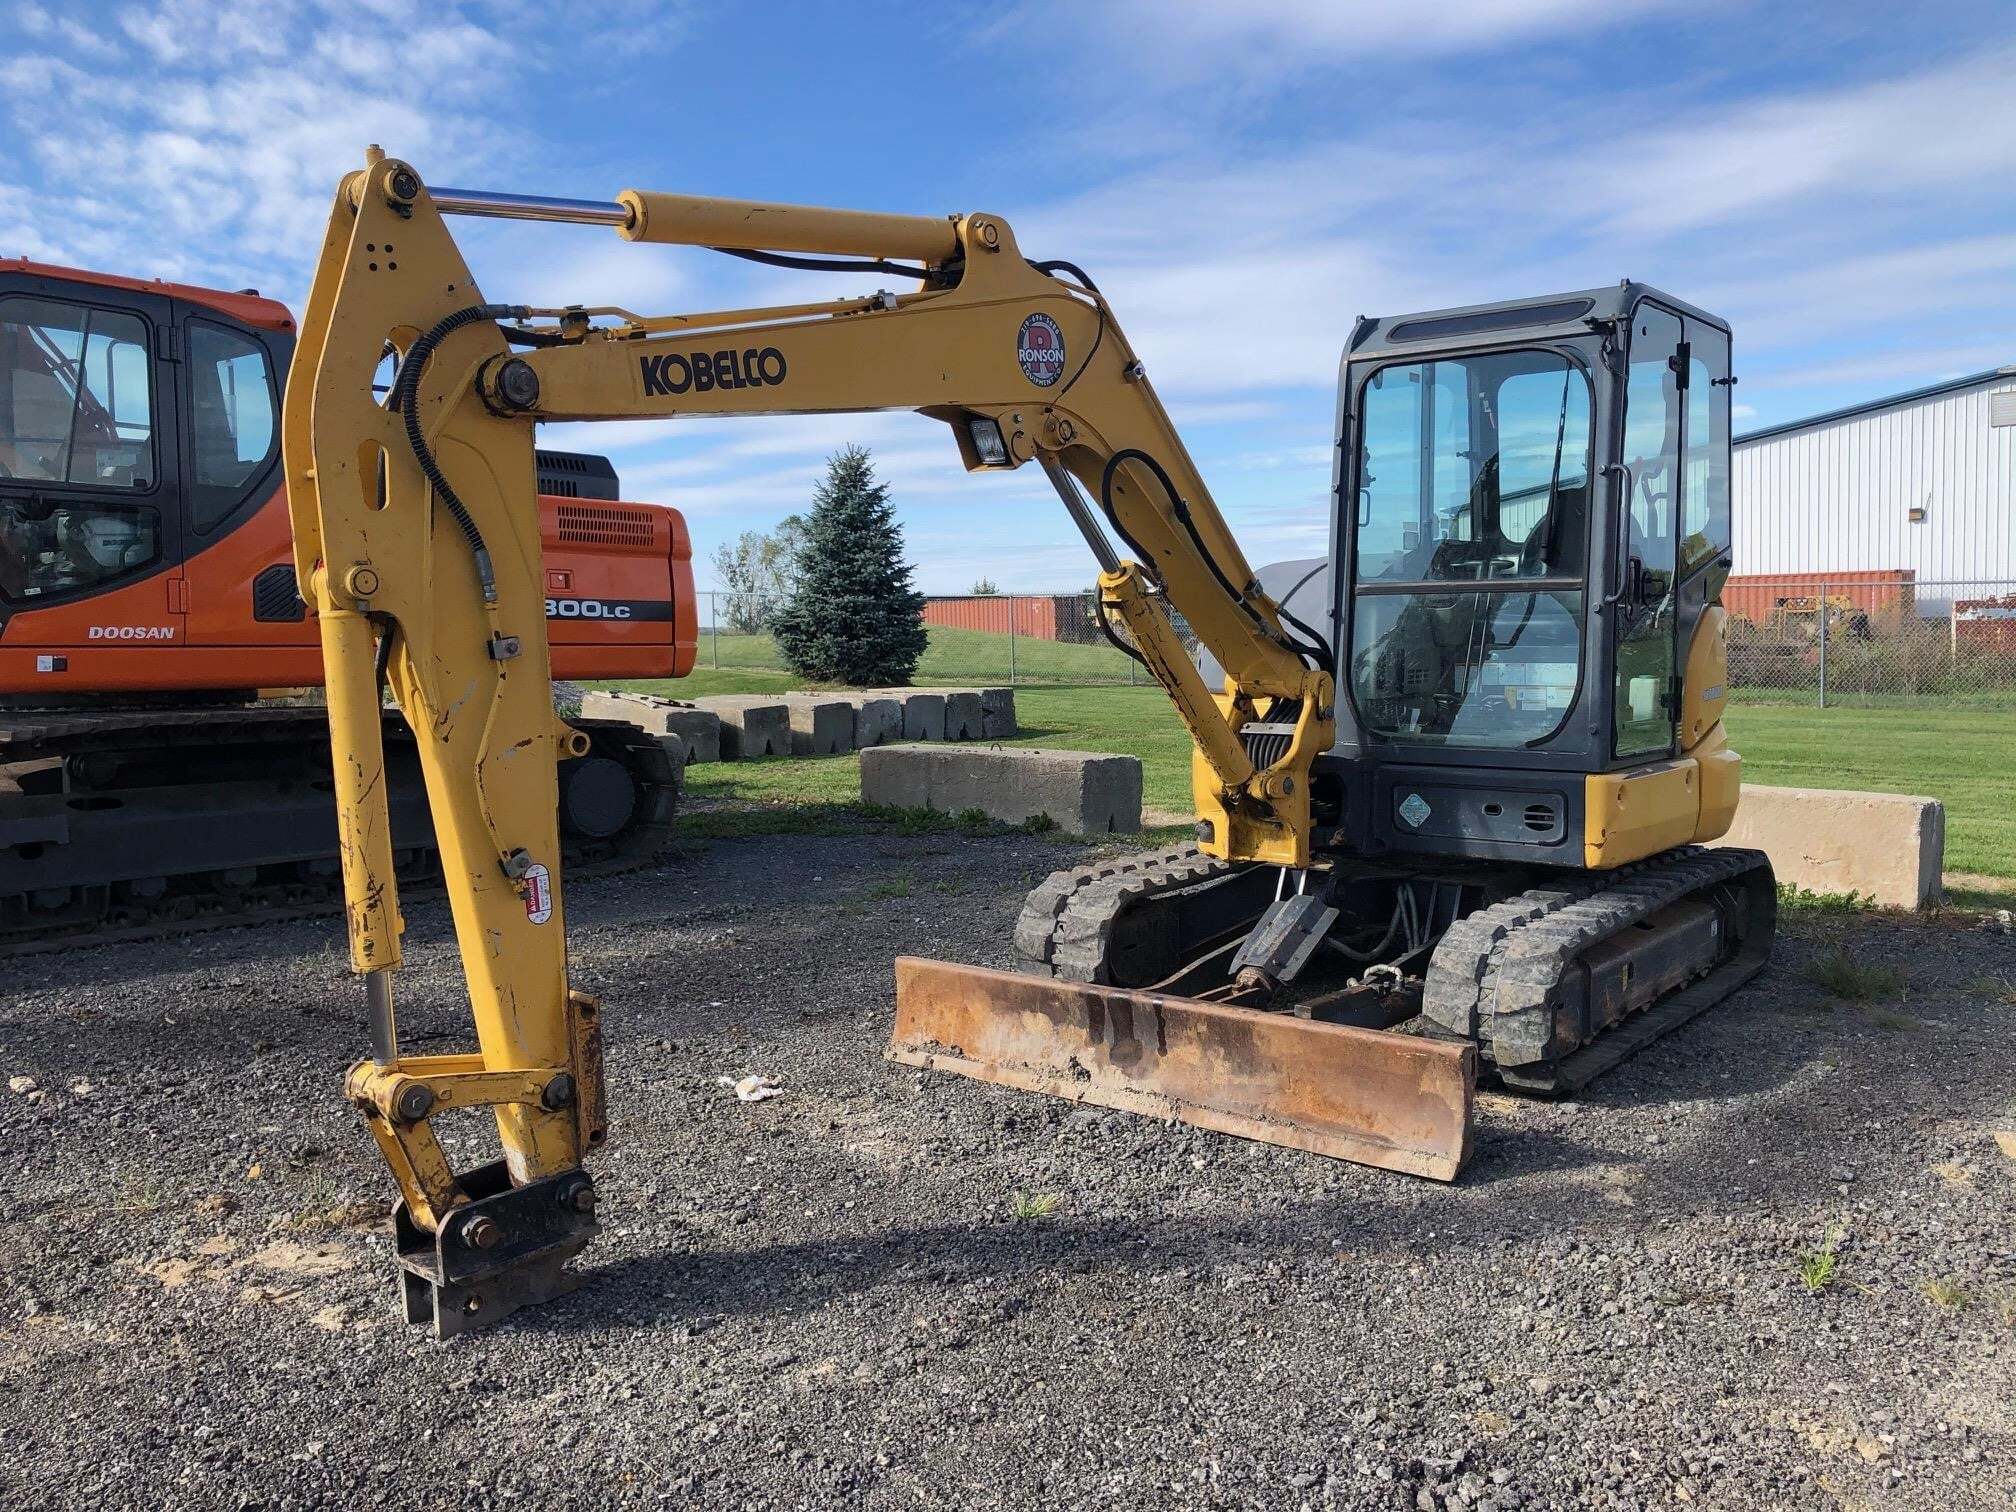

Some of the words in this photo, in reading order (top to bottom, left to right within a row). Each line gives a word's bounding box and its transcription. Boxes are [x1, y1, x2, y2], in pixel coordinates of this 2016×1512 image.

[1019, 349, 1064, 362] RONSON
[640, 347, 787, 397] KOBELCO
[1023, 365, 1054, 386] EQUIPMENT
[88, 626, 175, 639] DOOSAN
